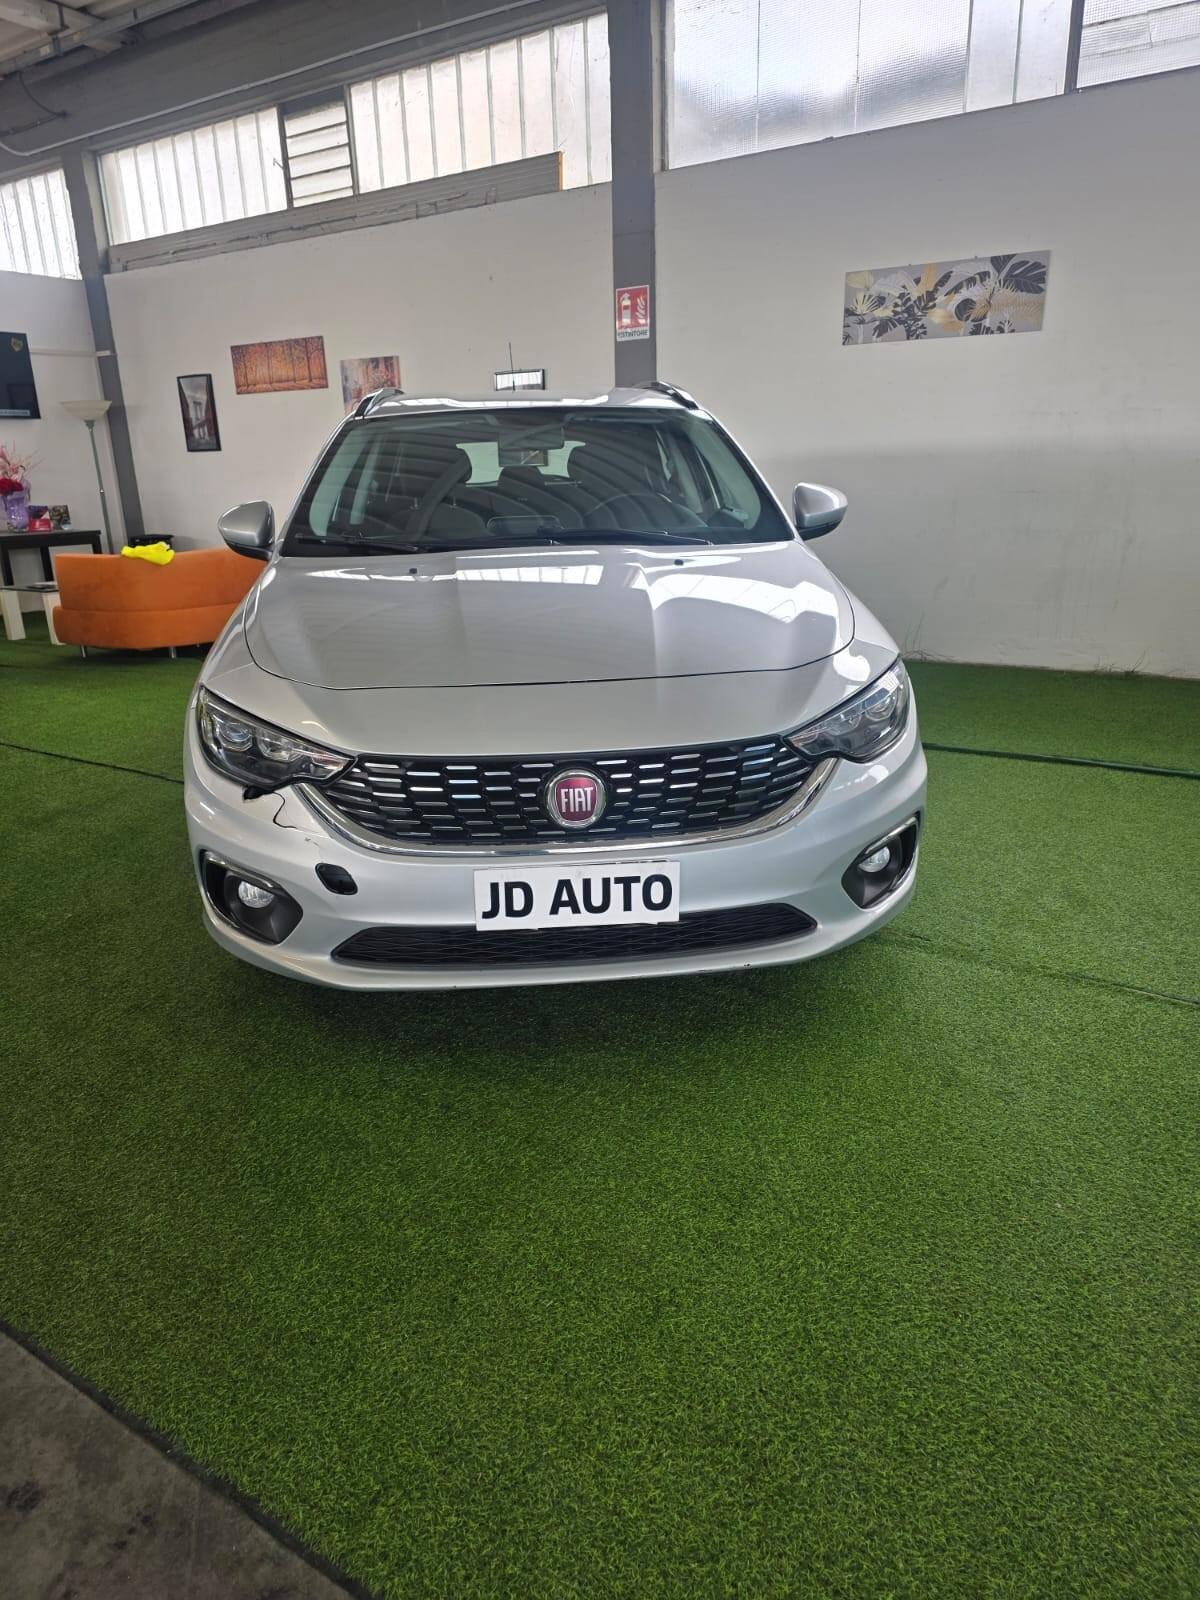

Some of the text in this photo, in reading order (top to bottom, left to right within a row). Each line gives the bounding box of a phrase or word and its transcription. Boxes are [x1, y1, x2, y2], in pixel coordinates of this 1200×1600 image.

[560, 786, 594, 813] FIAT
[481, 873, 673, 920] JD AUTO
